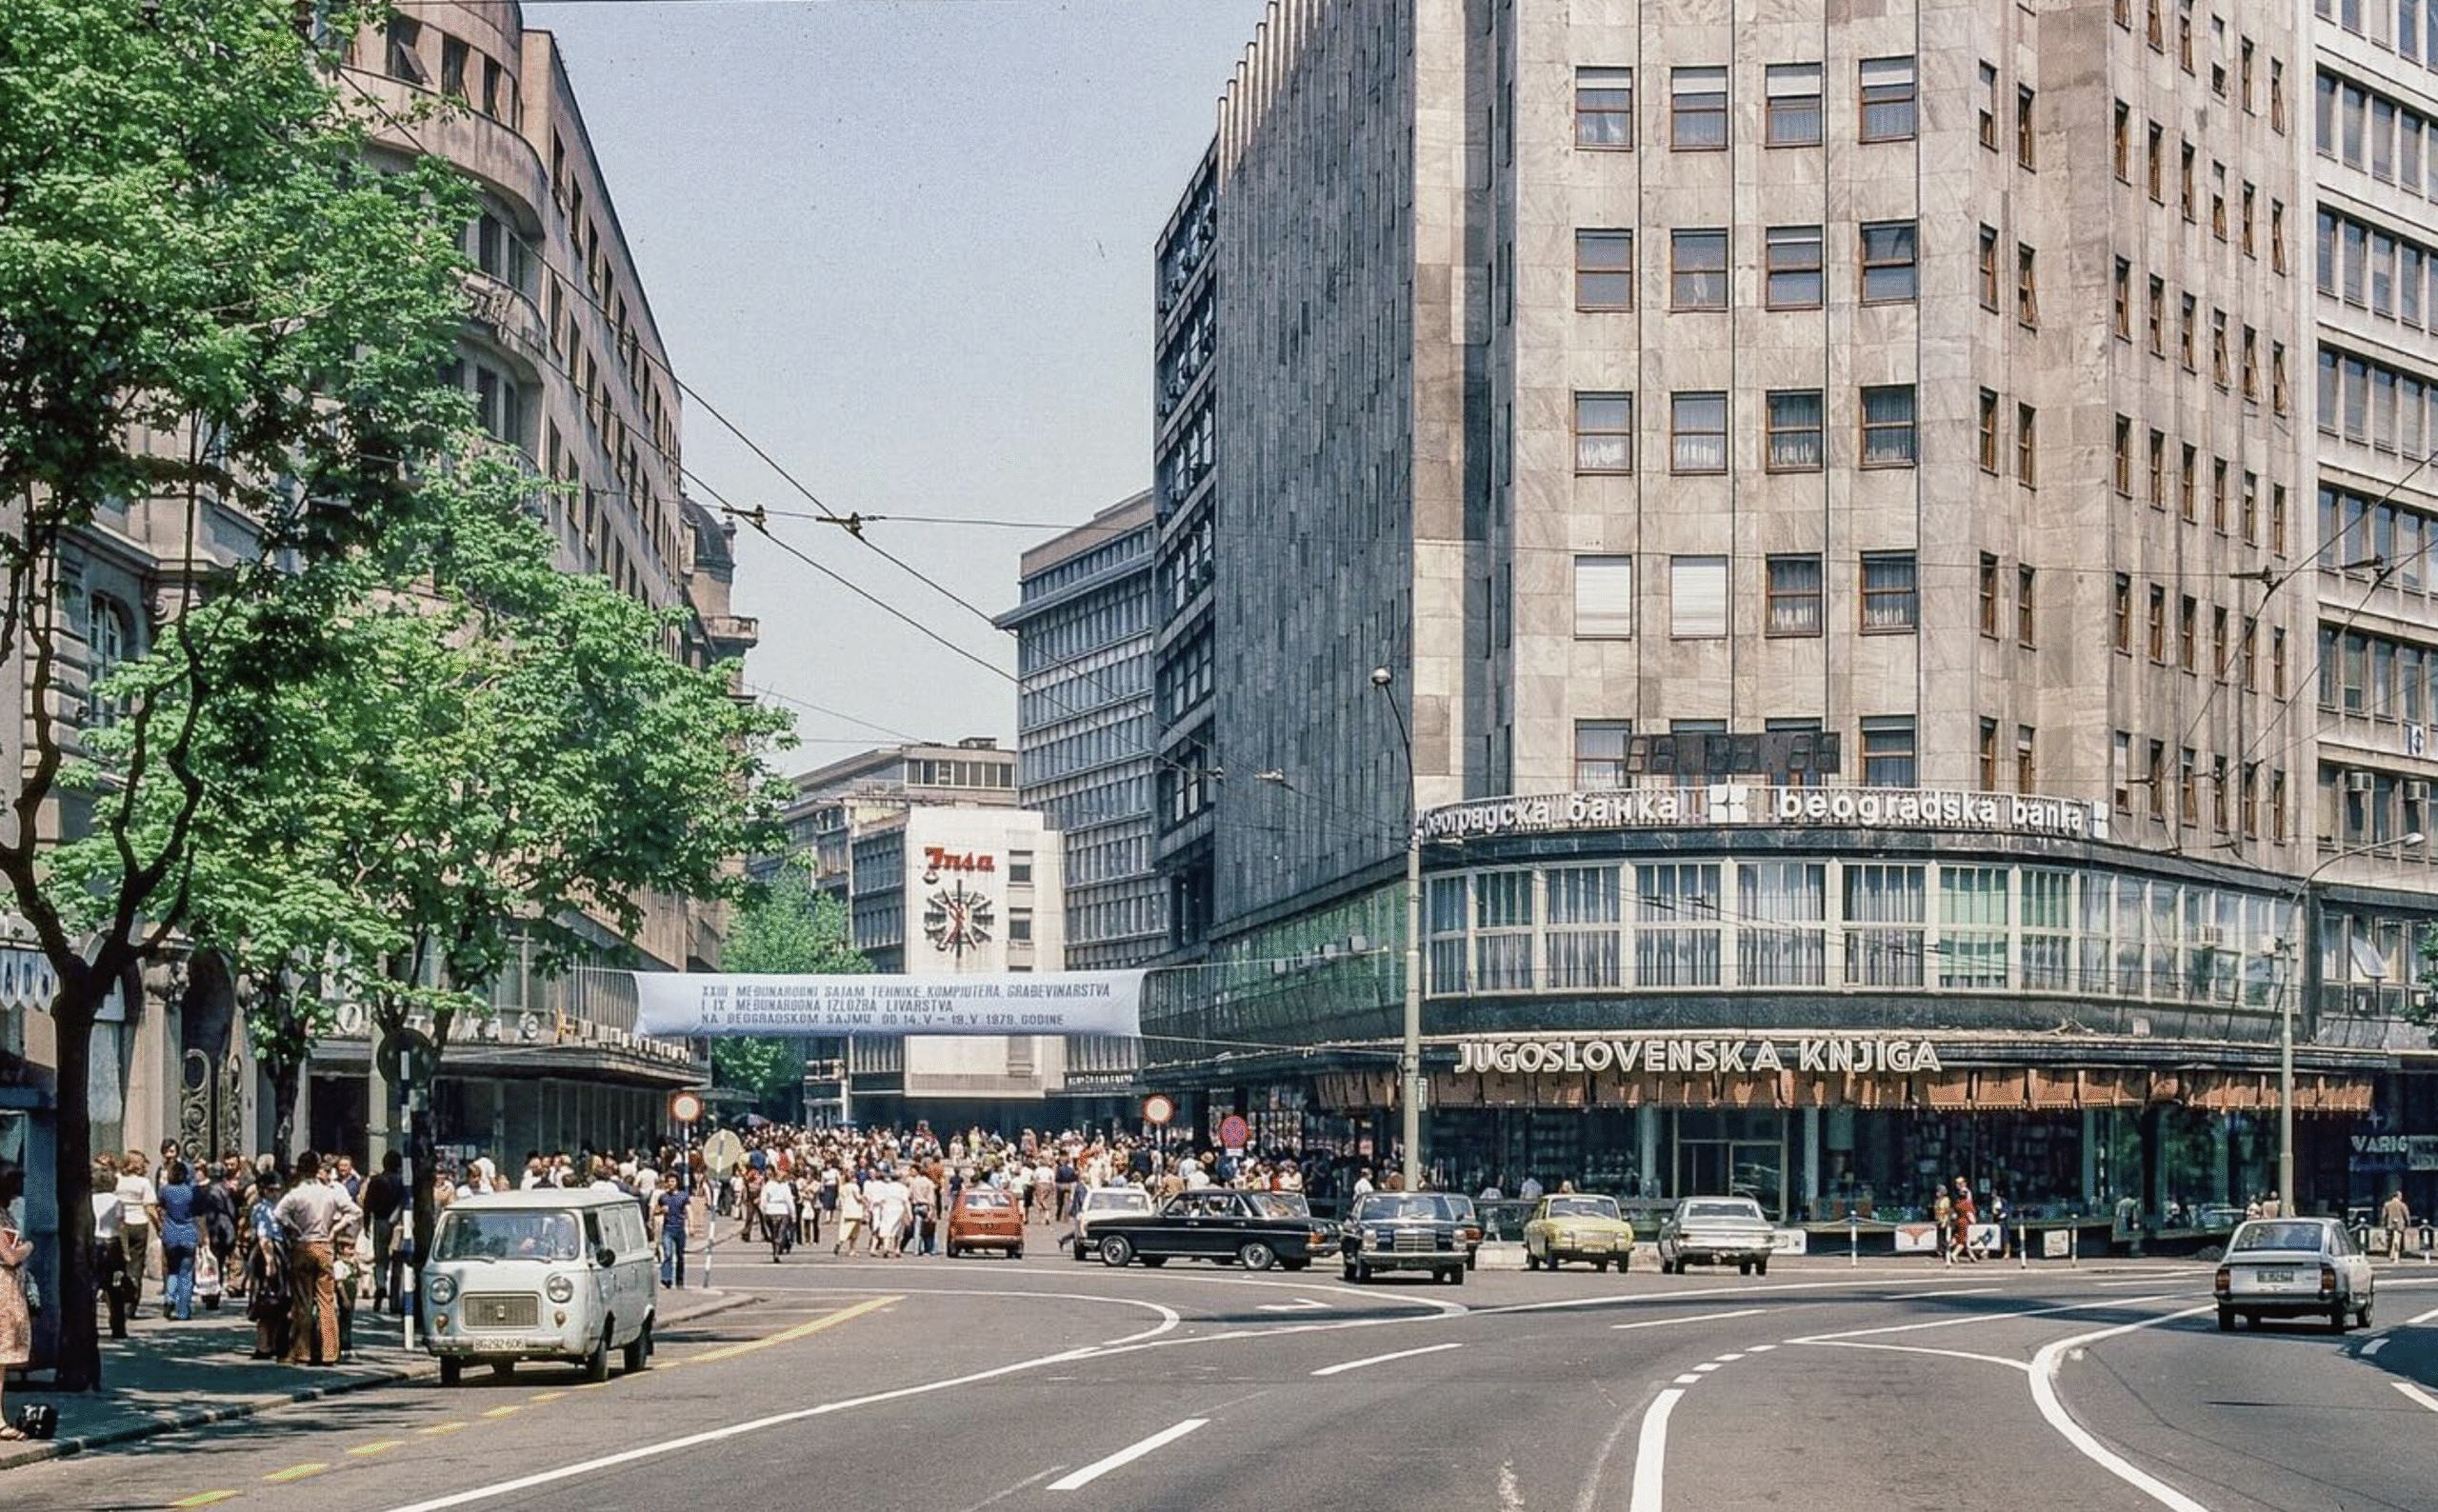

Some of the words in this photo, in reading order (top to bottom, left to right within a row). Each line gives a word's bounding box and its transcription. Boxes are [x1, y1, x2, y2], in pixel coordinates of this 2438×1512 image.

[1571, 792, 1679, 823] банка
[1779, 786, 1997, 825] beogradska
[2010, 796, 2083, 830] banka
[824, 985, 865, 998] SAJAM
[886, 1000, 953, 1012] LIVARSTVA
[702, 1013, 718, 1025] NA
[727, 1012, 819, 1025] BEOGRADSKOM
[827, 1013, 871, 1025] SAJMU
[881, 1014, 897, 1025] OD
[1021, 1014, 1064, 1025] GODINE
[1454, 1040, 1783, 1074] JUGOSLOVENSKA
[1799, 1038, 1942, 1073] KNJIGA
[2350, 1135, 2408, 1152] VARIG
